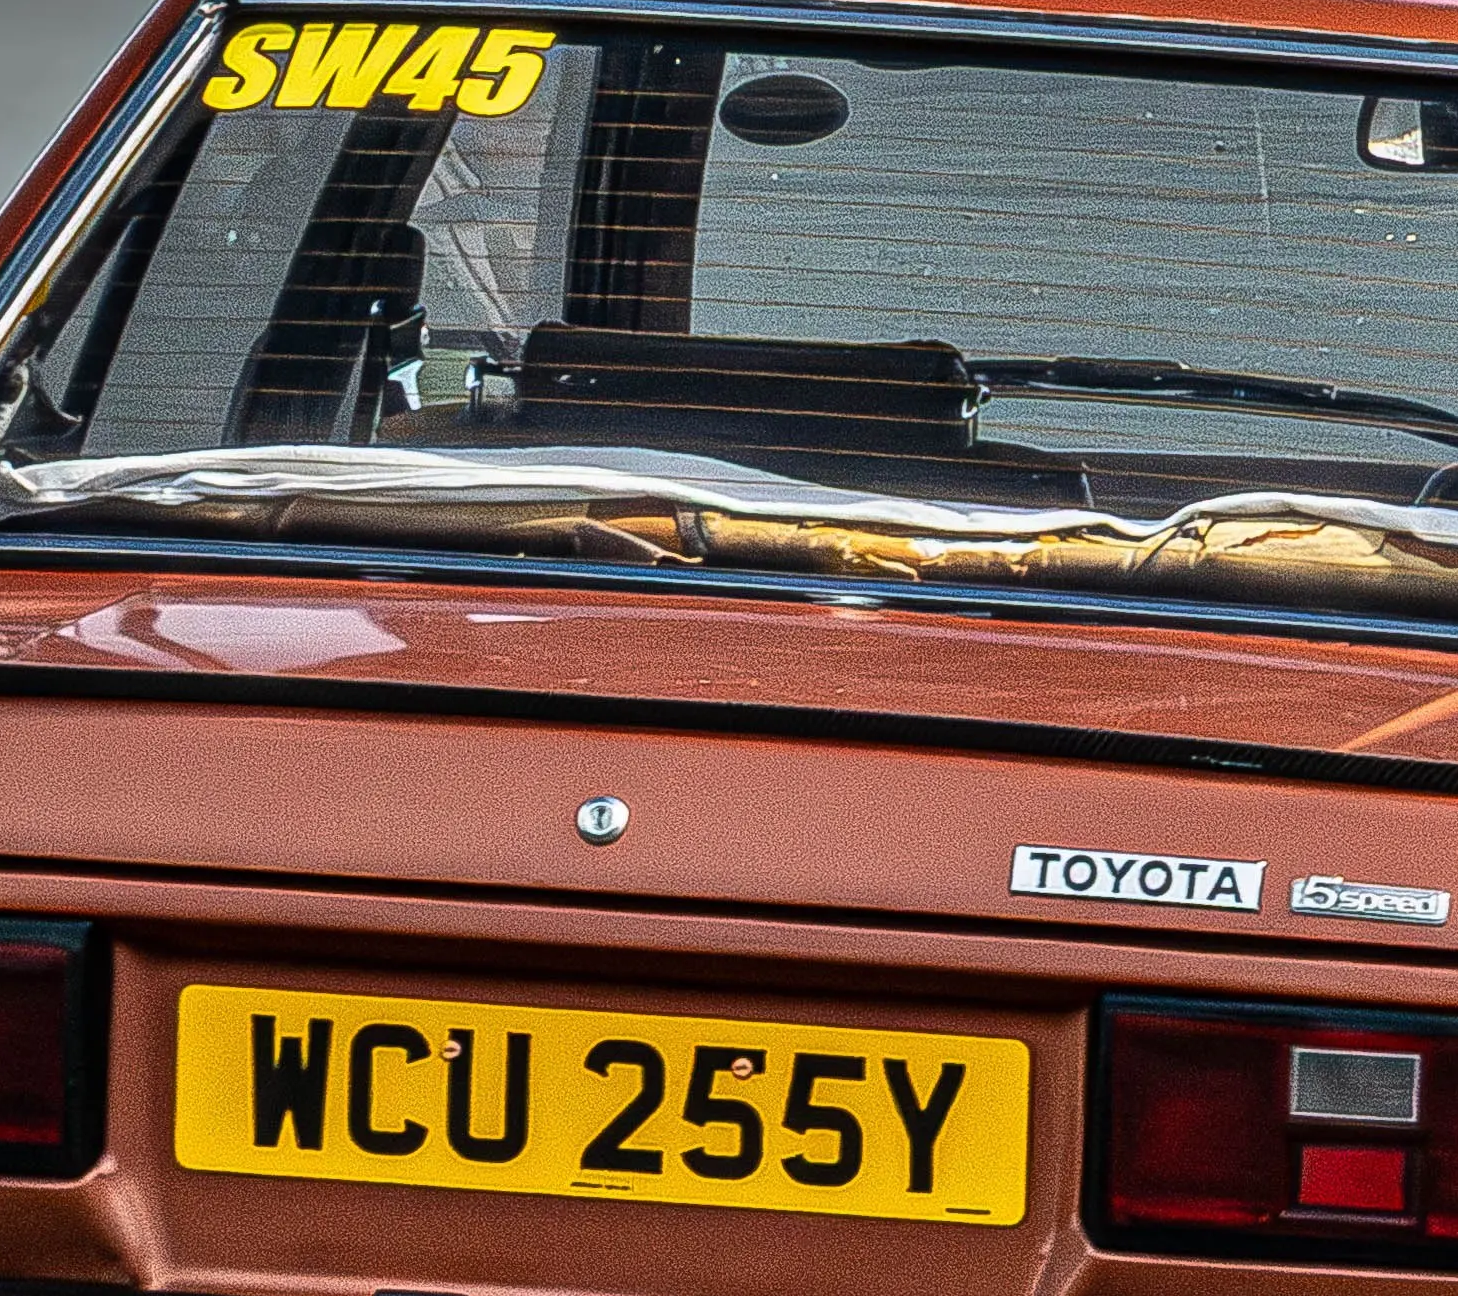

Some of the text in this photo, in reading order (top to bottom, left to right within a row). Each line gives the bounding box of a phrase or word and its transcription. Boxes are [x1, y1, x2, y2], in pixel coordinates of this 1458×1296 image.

[201, 22, 556, 116] SW45
[1030, 852, 1243, 903] TOYOTA
[251, 1014, 967, 1194] WCU 255Y
